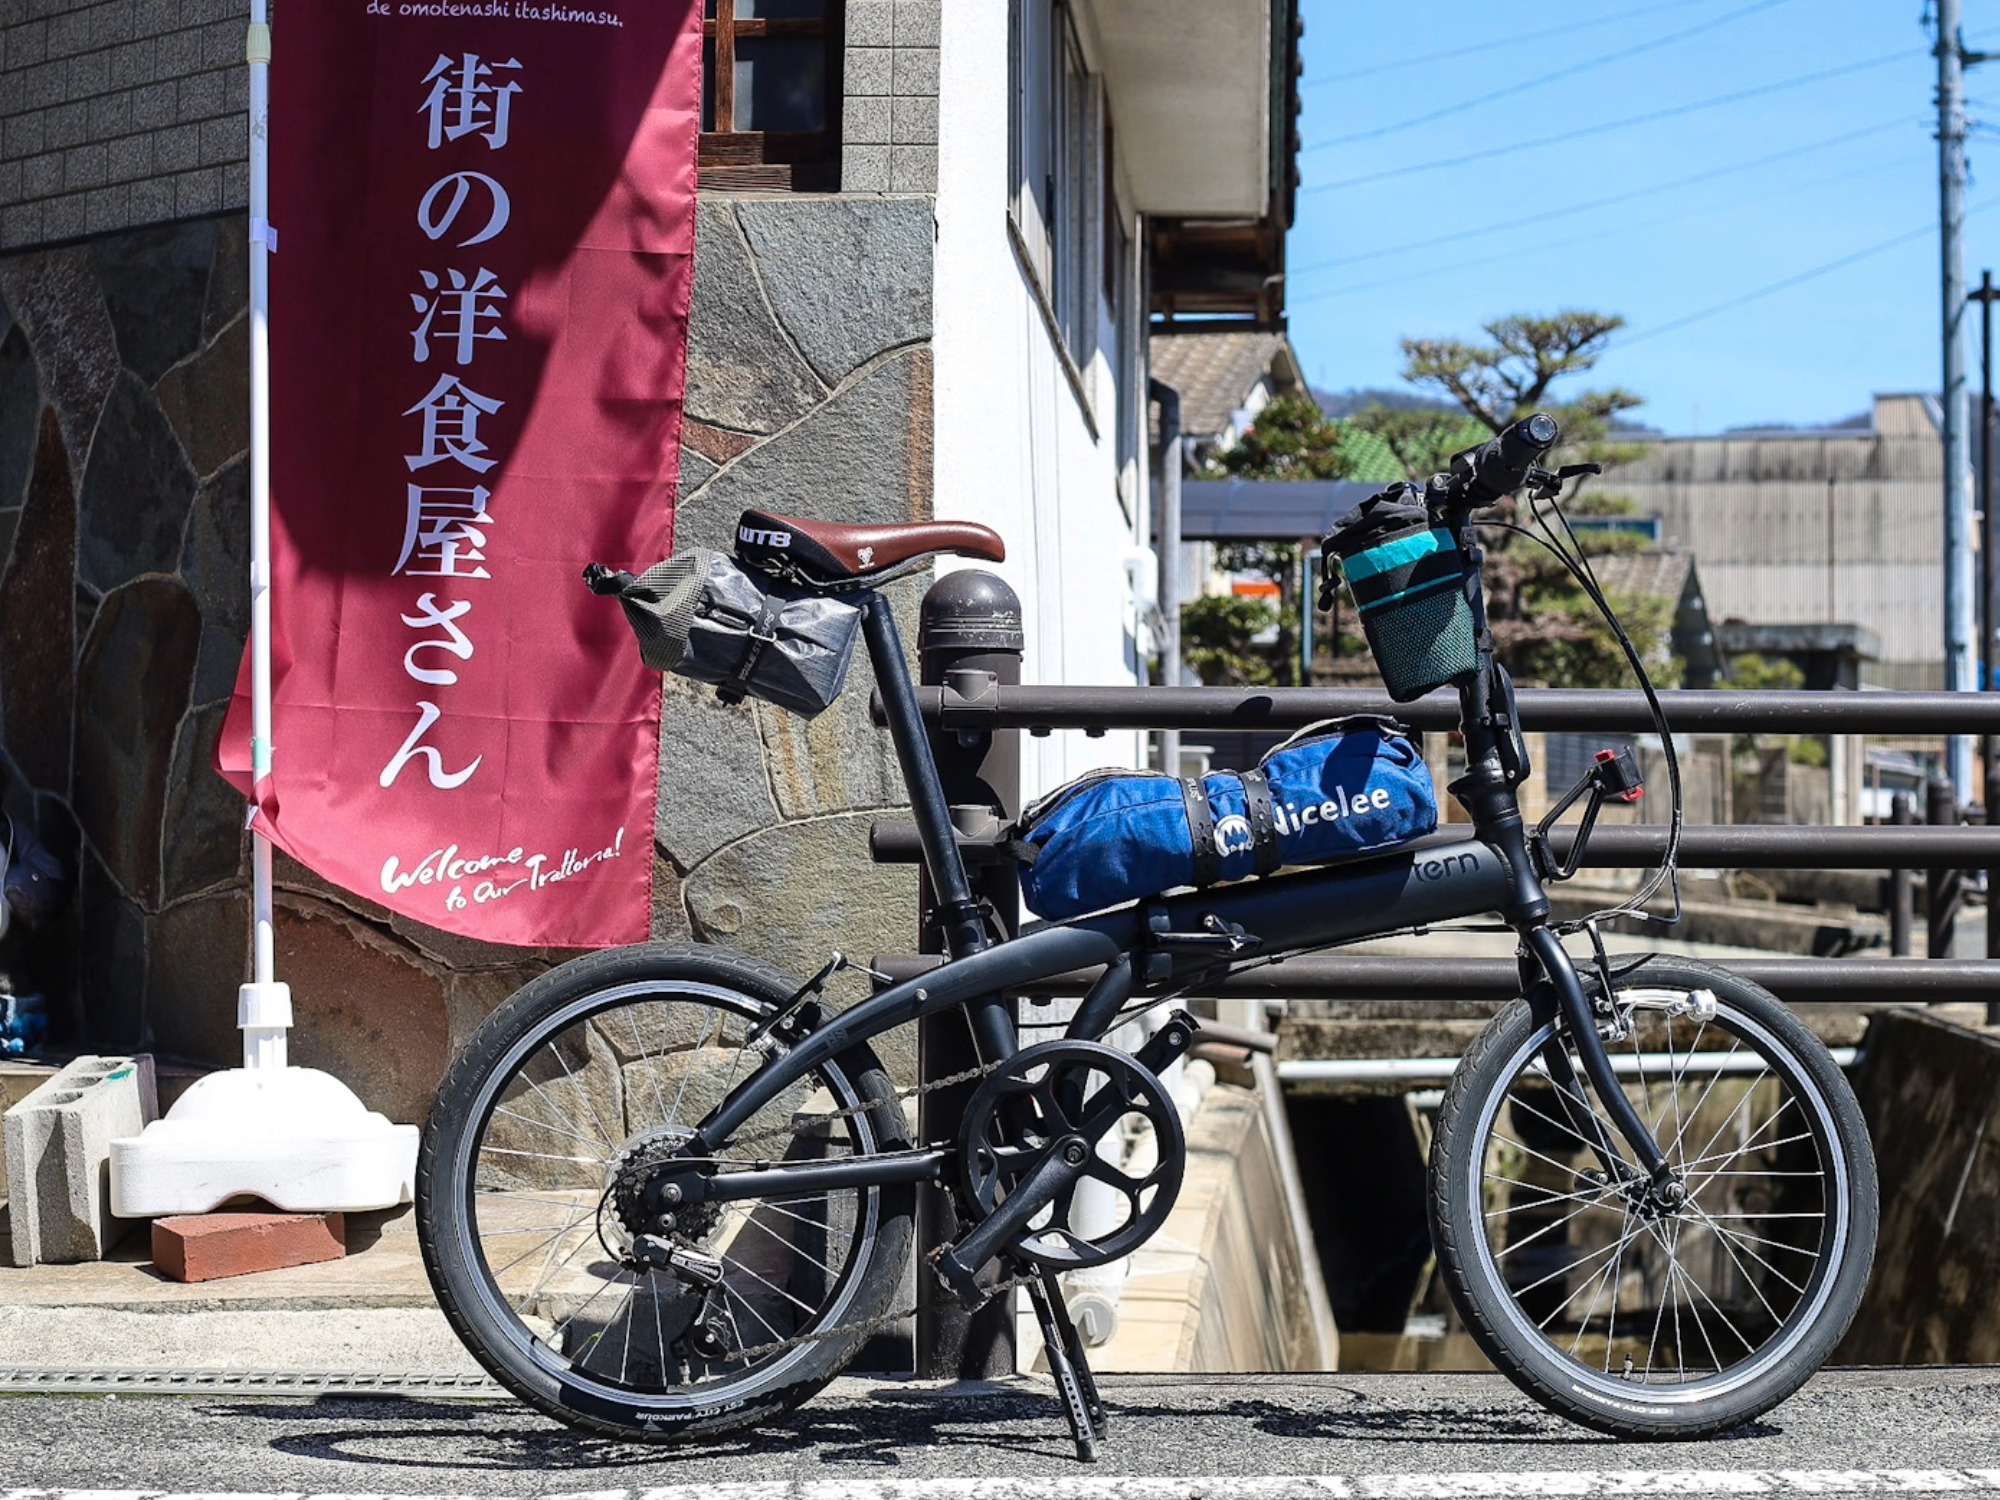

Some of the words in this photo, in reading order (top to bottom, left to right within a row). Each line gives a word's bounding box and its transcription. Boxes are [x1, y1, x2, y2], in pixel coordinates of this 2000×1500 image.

[367, 0, 391, 16] de
[399, 0, 511, 18] omotenashi
[514, 2, 624, 28] itashimasu.
[379, 52, 524, 790] 街の洋食屋さん
[739, 526, 792, 548] WTB
[381, 844, 524, 893] Welcome
[445, 886, 467, 912] to
[473, 880, 529, 904] Our
